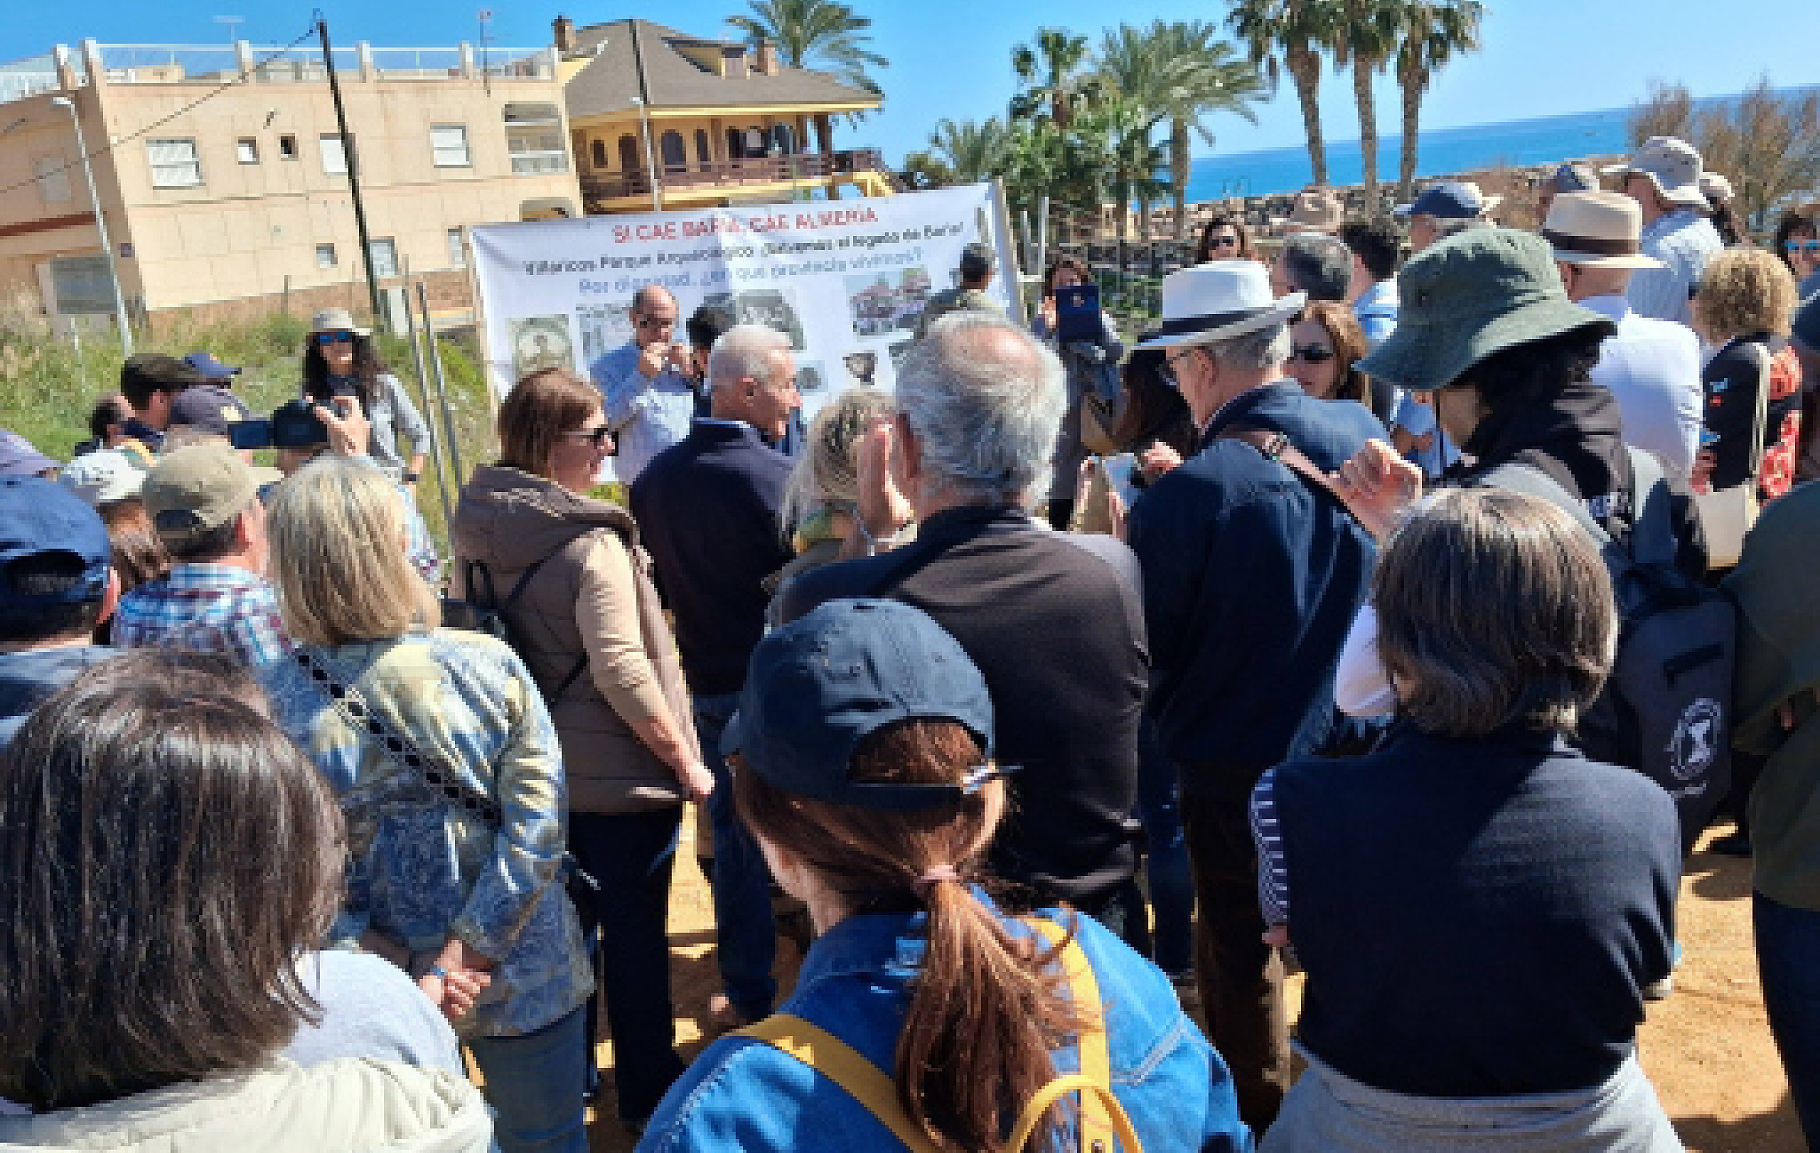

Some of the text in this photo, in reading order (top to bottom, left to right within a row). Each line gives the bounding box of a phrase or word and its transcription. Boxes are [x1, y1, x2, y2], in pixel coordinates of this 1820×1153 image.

[613, 224, 633, 244] SI
[636, 221, 679, 243] CAE
[749, 213, 790, 233] CAE
[837, 237, 850, 250] el
[853, 231, 899, 250] legado
[902, 227, 921, 241] de
[579, 278, 608, 294] Por
